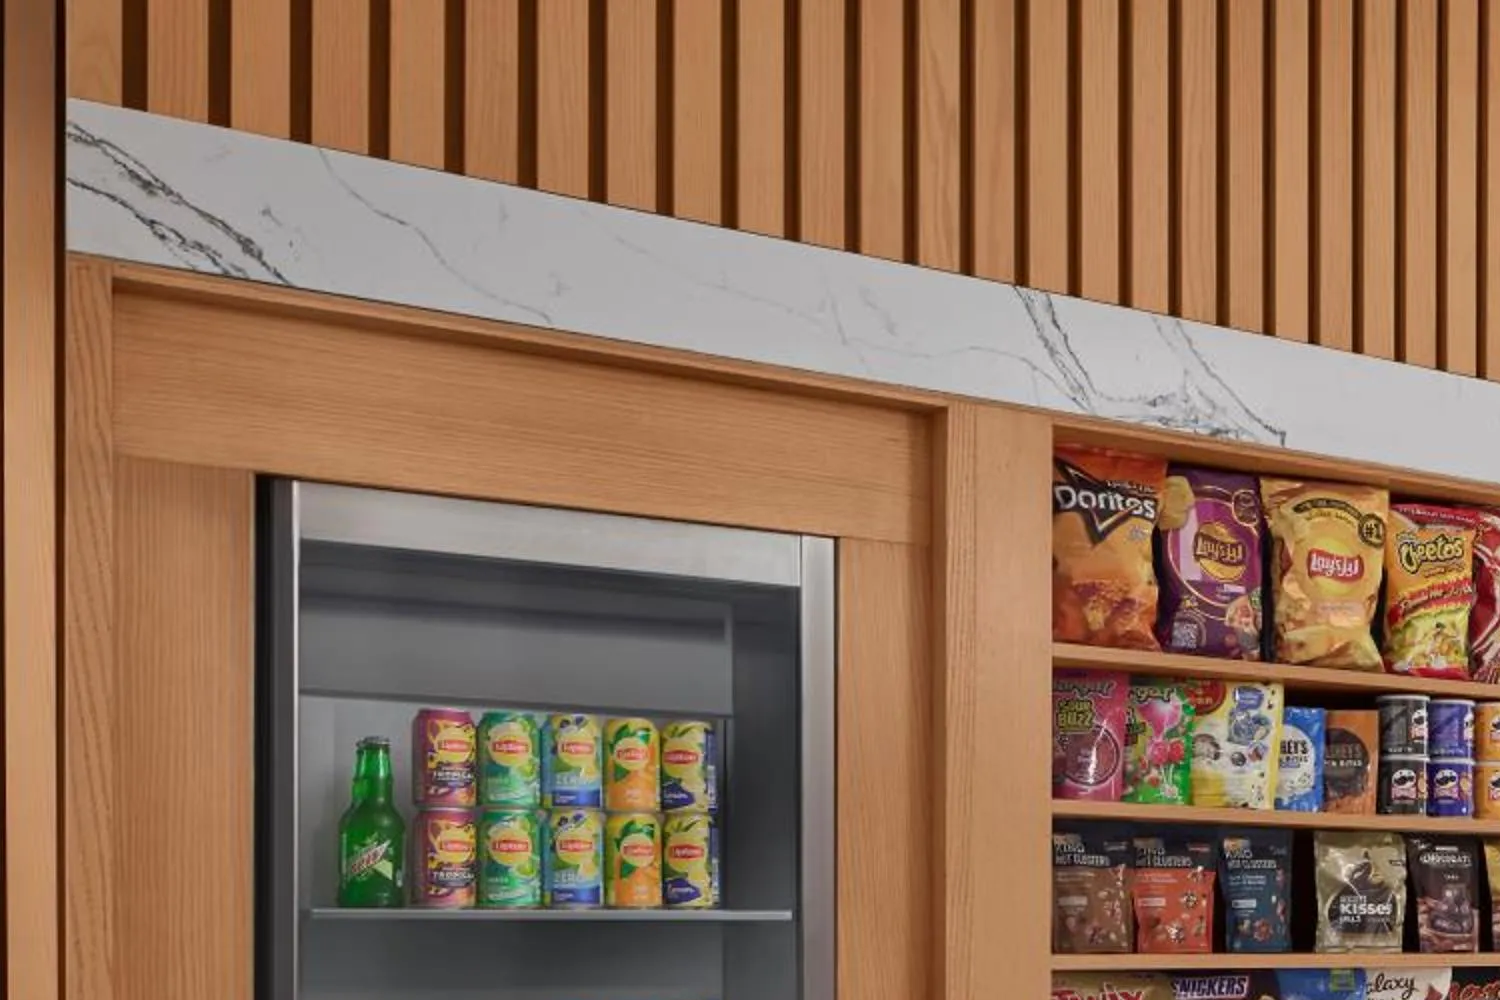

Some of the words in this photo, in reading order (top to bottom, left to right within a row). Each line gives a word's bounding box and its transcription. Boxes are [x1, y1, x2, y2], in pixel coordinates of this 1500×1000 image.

[1054, 485, 1156, 520] Doritos
[1399, 535, 1464, 574] Cheetos
[1174, 976, 1249, 998] SNICKERS
